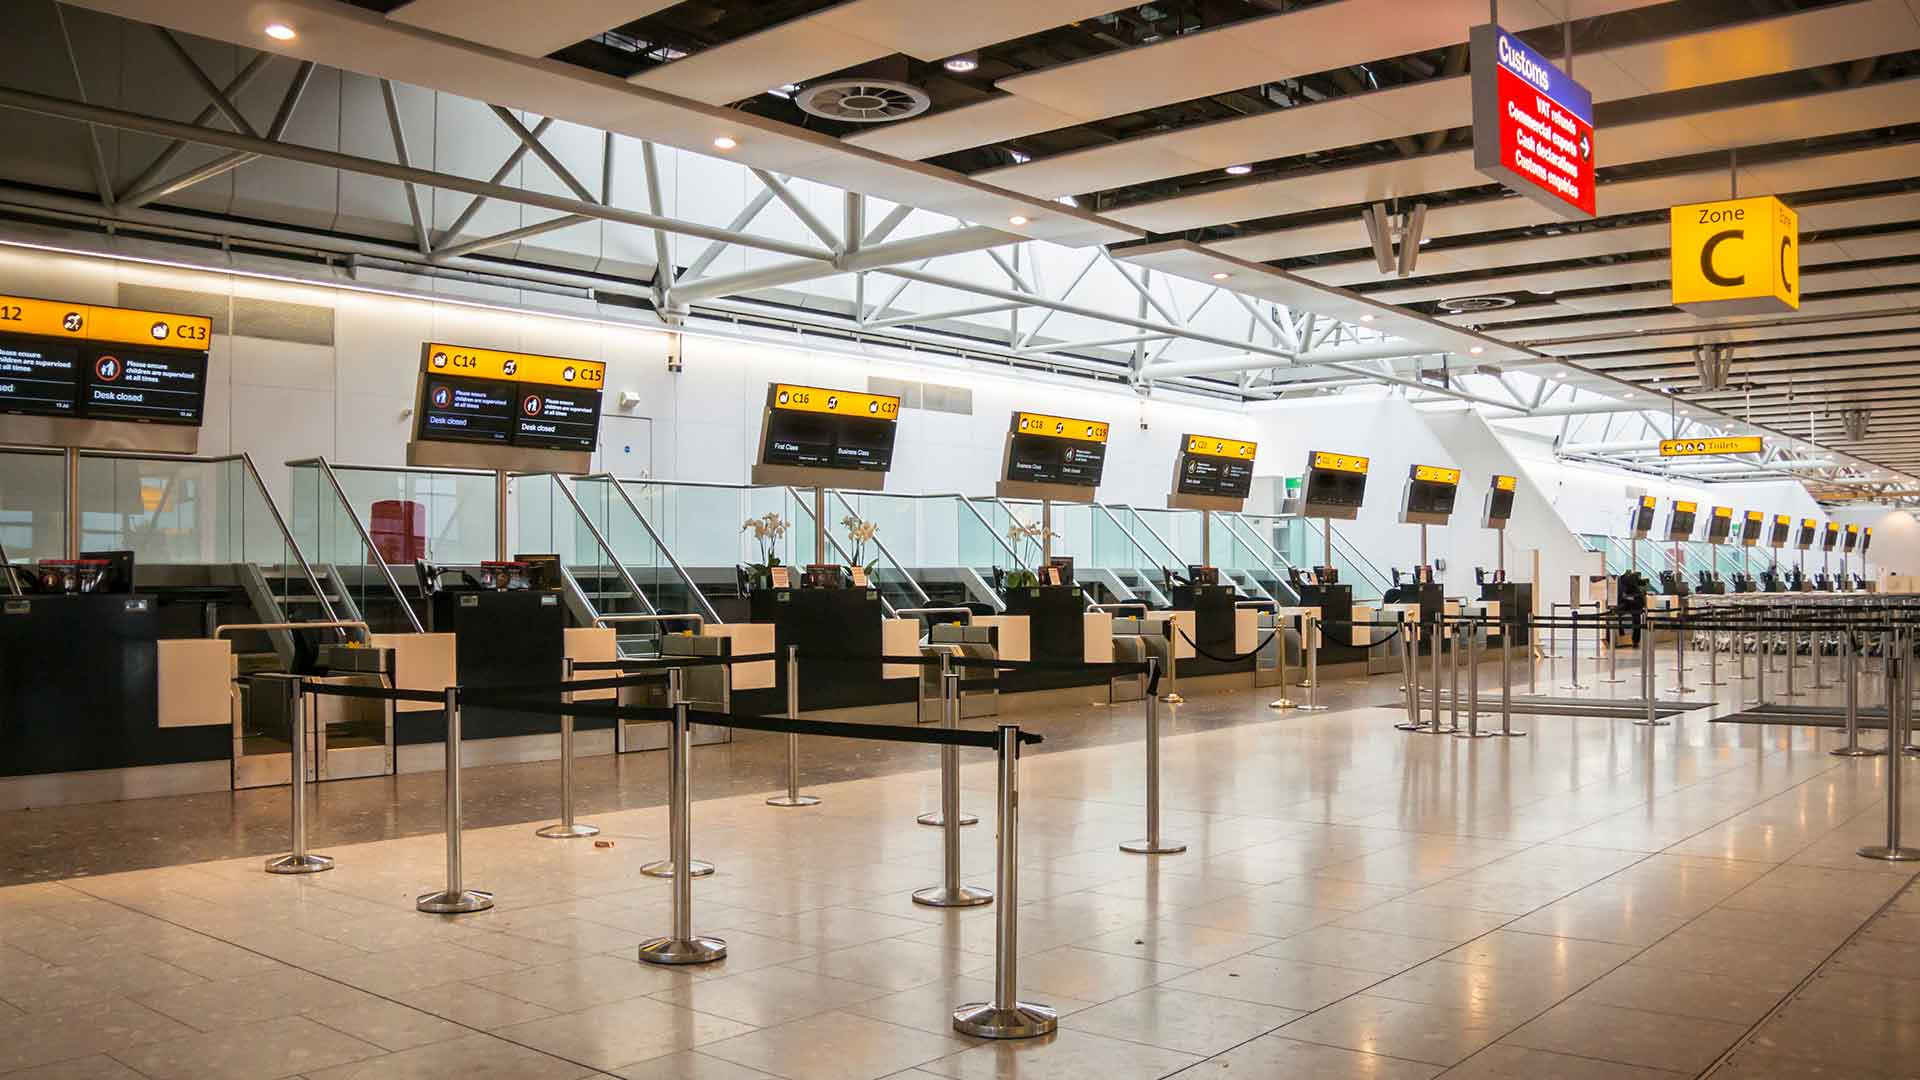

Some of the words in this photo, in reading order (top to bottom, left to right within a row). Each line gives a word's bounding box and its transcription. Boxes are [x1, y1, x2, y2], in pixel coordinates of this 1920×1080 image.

[1499, 36, 1549, 91] Customs
[1536, 96, 1551, 115] VAT
[1551, 109, 1577, 135] refunds
[1508, 101, 1551, 142] Commercial
[1552, 130, 1578, 157] exports
[1516, 128, 1536, 153] Cash
[1536, 142, 1578, 178] declarations
[1515, 149, 1547, 181] Customs
[1547, 172, 1579, 199] enquiries
[1699, 208, 1745, 224] Zone
[1700, 229, 1745, 287] C
[1780, 235, 1792, 293] C
[0, 306, 22, 321] 12
[176, 325, 206, 340] C13
[0, 356, 22, 364] hildren
[35, 360, 72, 369] supervised
[12, 364, 32, 372] times
[126, 360, 146, 369] Please
[453, 355, 477, 368] C14
[125, 367, 151, 375] children
[162, 371, 195, 380] supervised
[580, 369, 601, 381] C15
[94, 390, 115, 400] Desk
[116, 391, 143, 402] closed
[792, 393, 809, 404] C16
[881, 402, 897, 413] C17
[430, 416, 446, 424] Desk
[447, 417, 467, 426] closed
[521, 423, 536, 431] Desk
[536, 424, 556, 432] closed
[1030, 420, 1043, 429] C18
[786, 443, 799, 451] Class
[1708, 441, 1738, 449] Toilets
[837, 448, 857, 456] Business
[857, 449, 870, 457] Class
